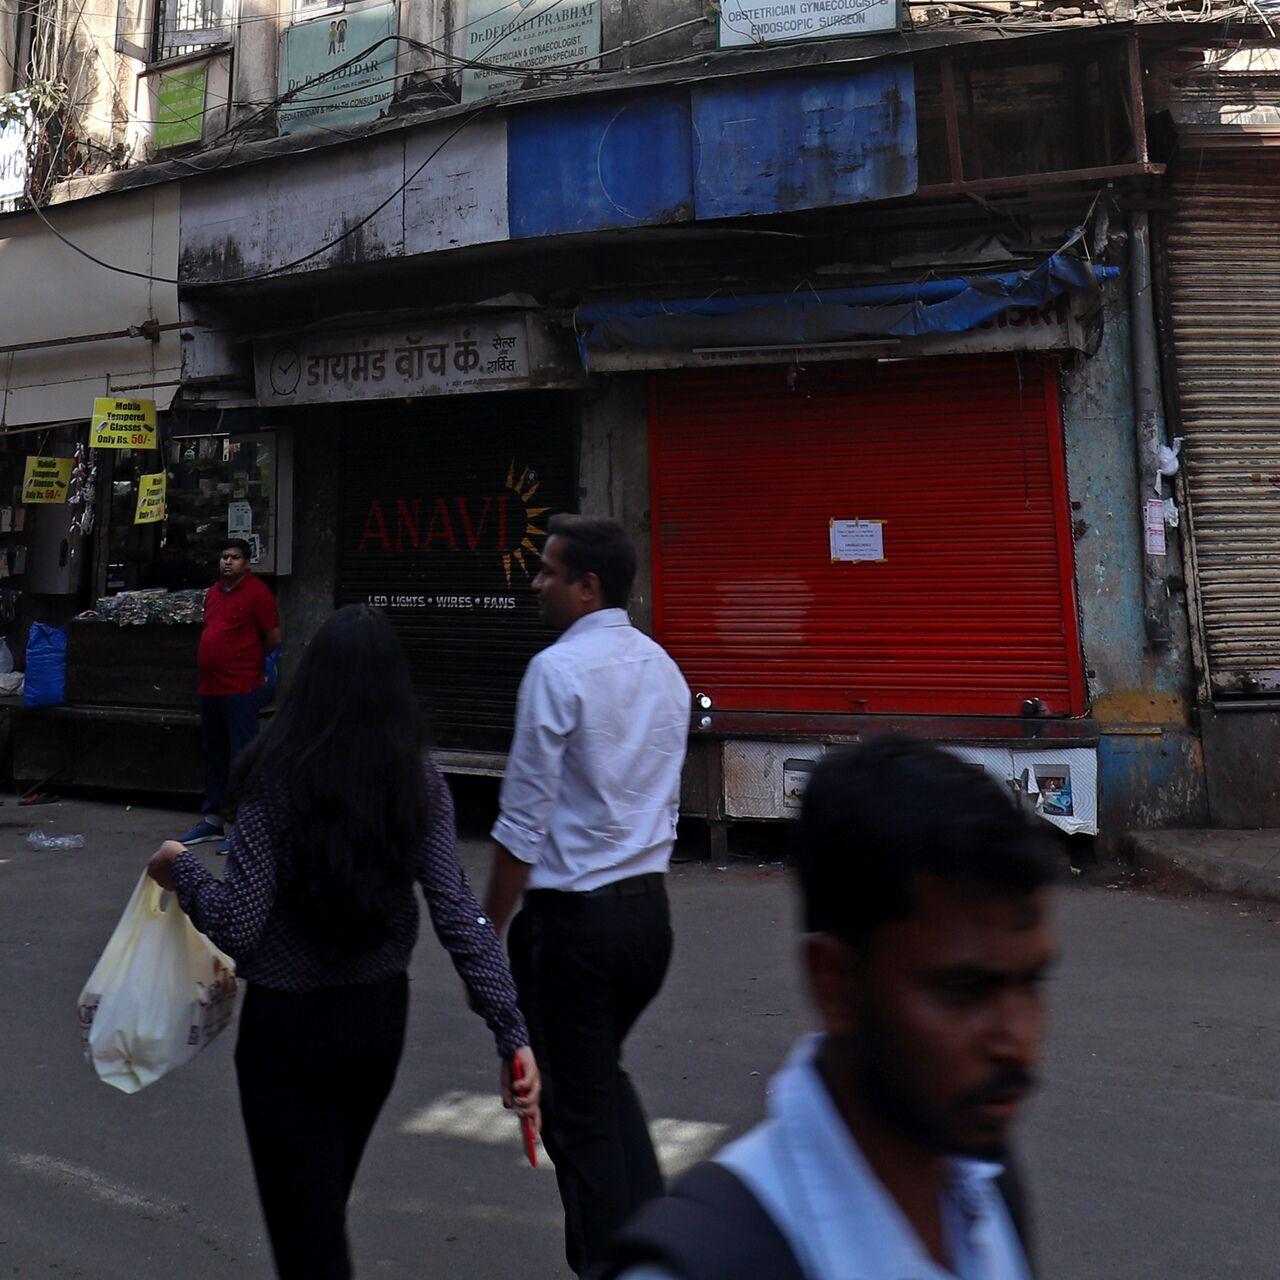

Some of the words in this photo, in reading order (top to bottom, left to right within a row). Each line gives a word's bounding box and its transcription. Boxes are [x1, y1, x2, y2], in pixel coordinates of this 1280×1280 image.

[538, 2, 596, 28] PRABHAT
[728, 3, 796, 23] OBSTETRICIAN
[751, 17, 814, 36] ENDOSCOPIC
[819, 12, 866, 27] SURGEON
[350, 92, 391, 107] CONSULTANT
[492, 335, 517, 350] सेल्स
[306, 336, 389, 386] डायमंड
[394, 335, 449, 381] वॉच
[115, 402, 141, 411] Mobile
[107, 412, 146, 421] Tempered
[110, 422, 142, 432] Glasses
[97, 434, 116, 445] Only
[116, 435, 129, 444] Rs.
[131, 434, 152, 445] 50/-
[358, 495, 510, 552] ANAVI
[368, 595, 388, 607] LED
[390, 595, 425, 608] LIGHTS
[435, 595, 473, 609] WIRES
[483, 596, 516, 609] FANS
